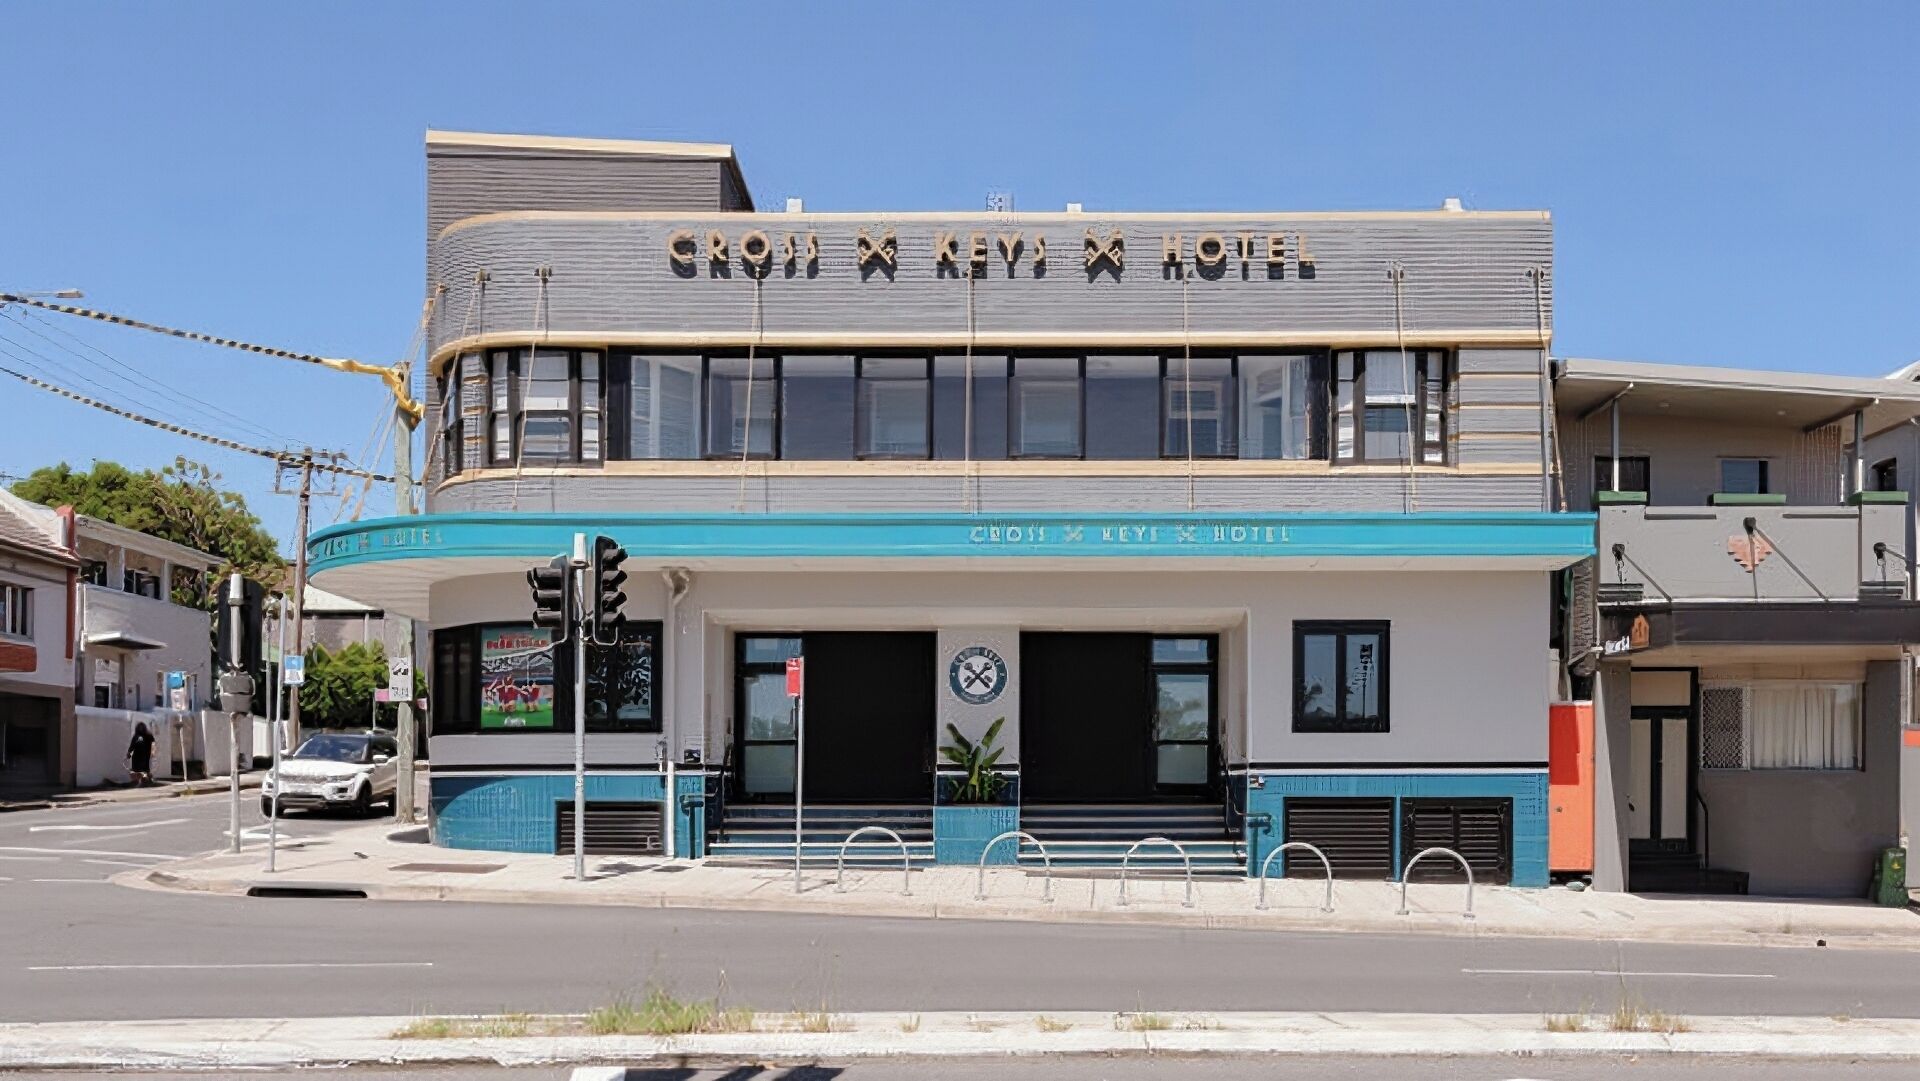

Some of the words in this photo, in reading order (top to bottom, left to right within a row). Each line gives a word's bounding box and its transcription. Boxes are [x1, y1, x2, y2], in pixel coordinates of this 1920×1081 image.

[667, 229, 819, 268] CROSS
[935, 229, 1046, 268] KEYS
[1161, 229, 1316, 268] HOTEL
